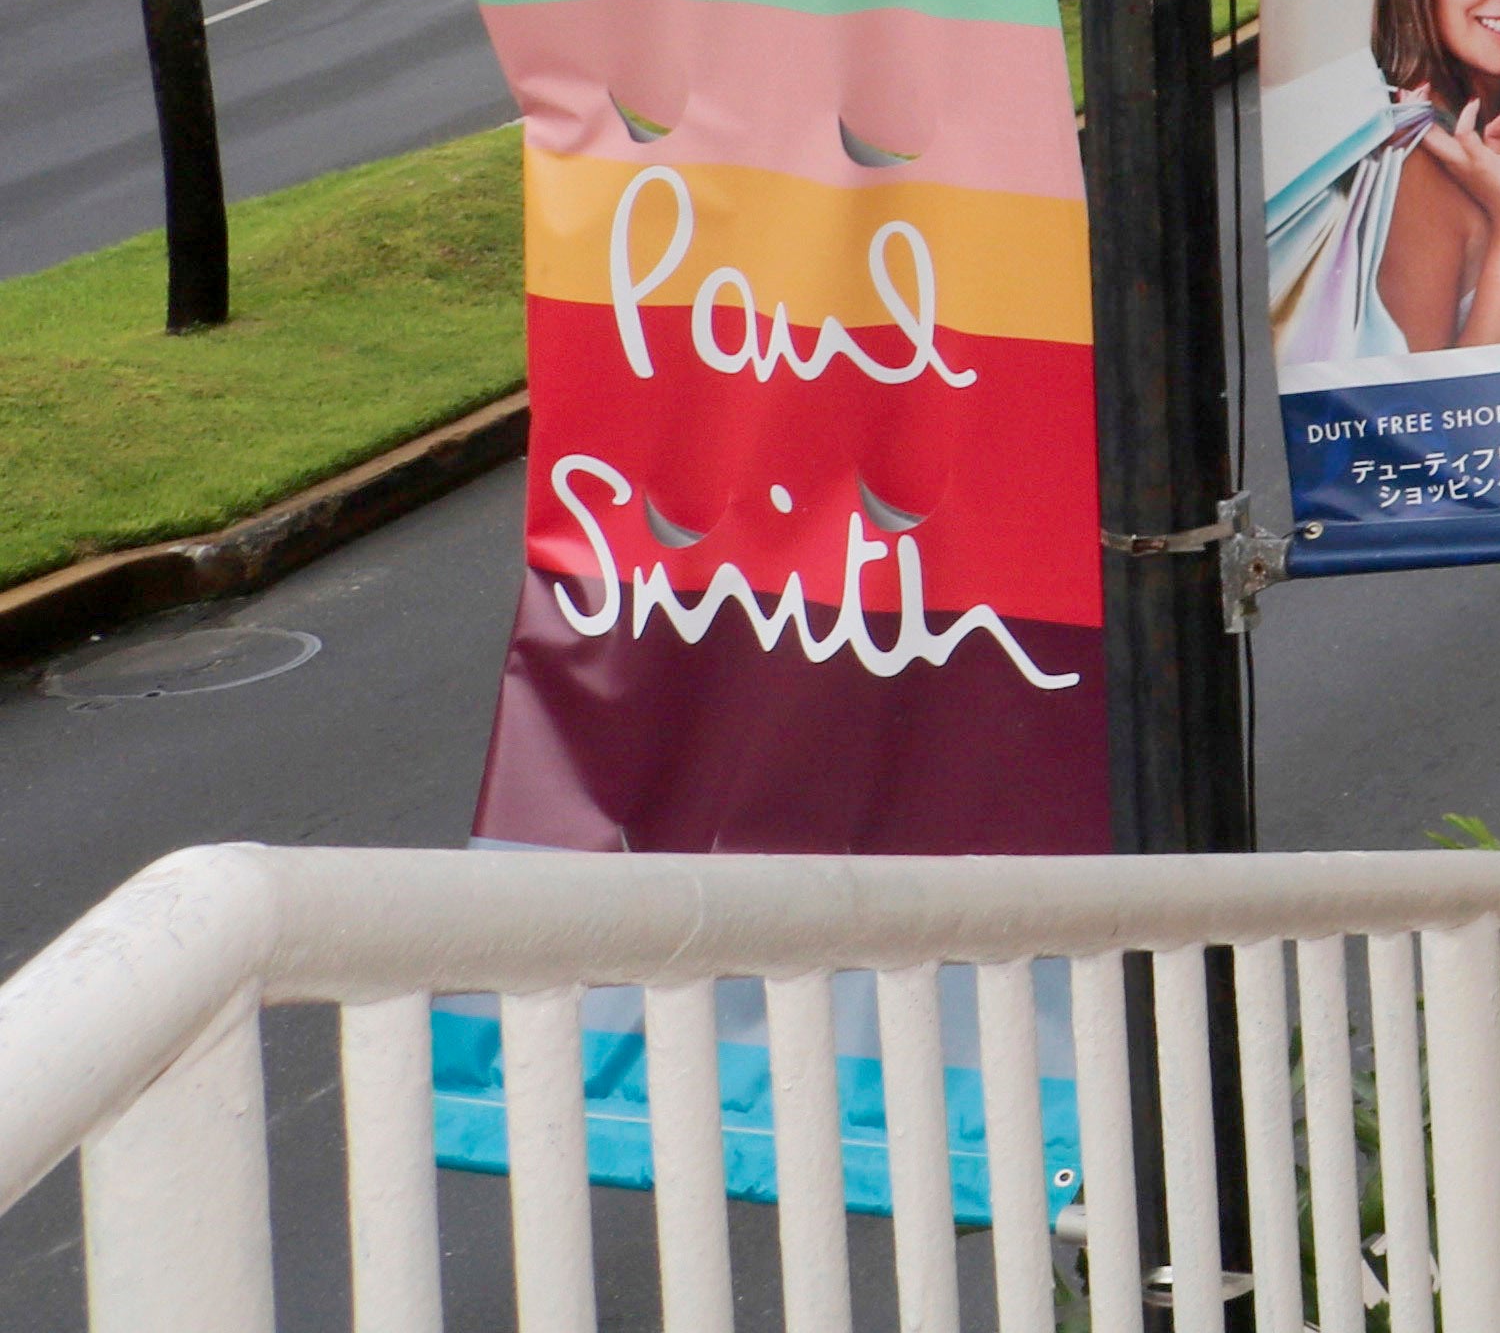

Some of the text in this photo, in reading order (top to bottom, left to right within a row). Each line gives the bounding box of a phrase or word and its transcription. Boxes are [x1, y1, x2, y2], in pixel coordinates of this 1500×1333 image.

[609, 165, 977, 388] Paul
[1307, 418, 1369, 445] DUTY
[1377, 410, 1433, 437] FREE
[551, 453, 1080, 689] Smith
